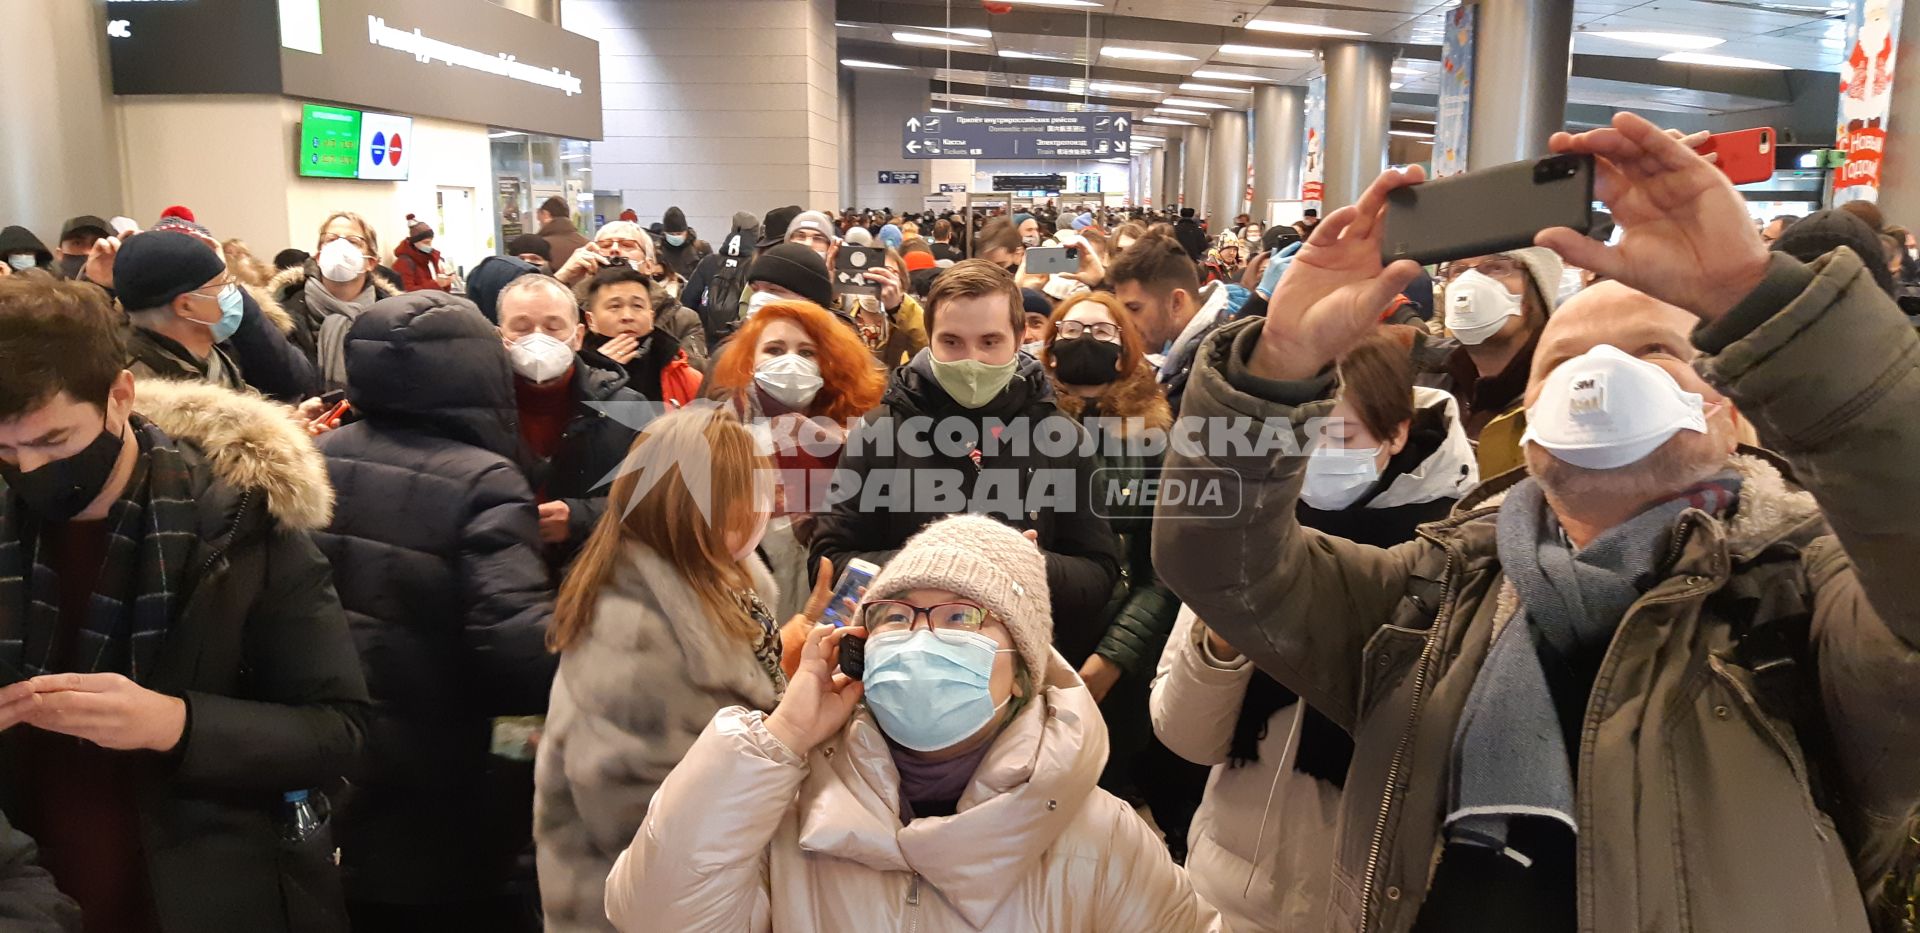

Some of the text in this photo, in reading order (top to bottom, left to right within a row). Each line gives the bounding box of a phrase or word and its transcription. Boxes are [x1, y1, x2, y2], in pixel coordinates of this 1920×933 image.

[1051, 116, 1078, 125] рейсов
[988, 125, 1021, 133] Domestic
[942, 138, 967, 146] Кассы
[1573, 379, 1595, 391] 3M
